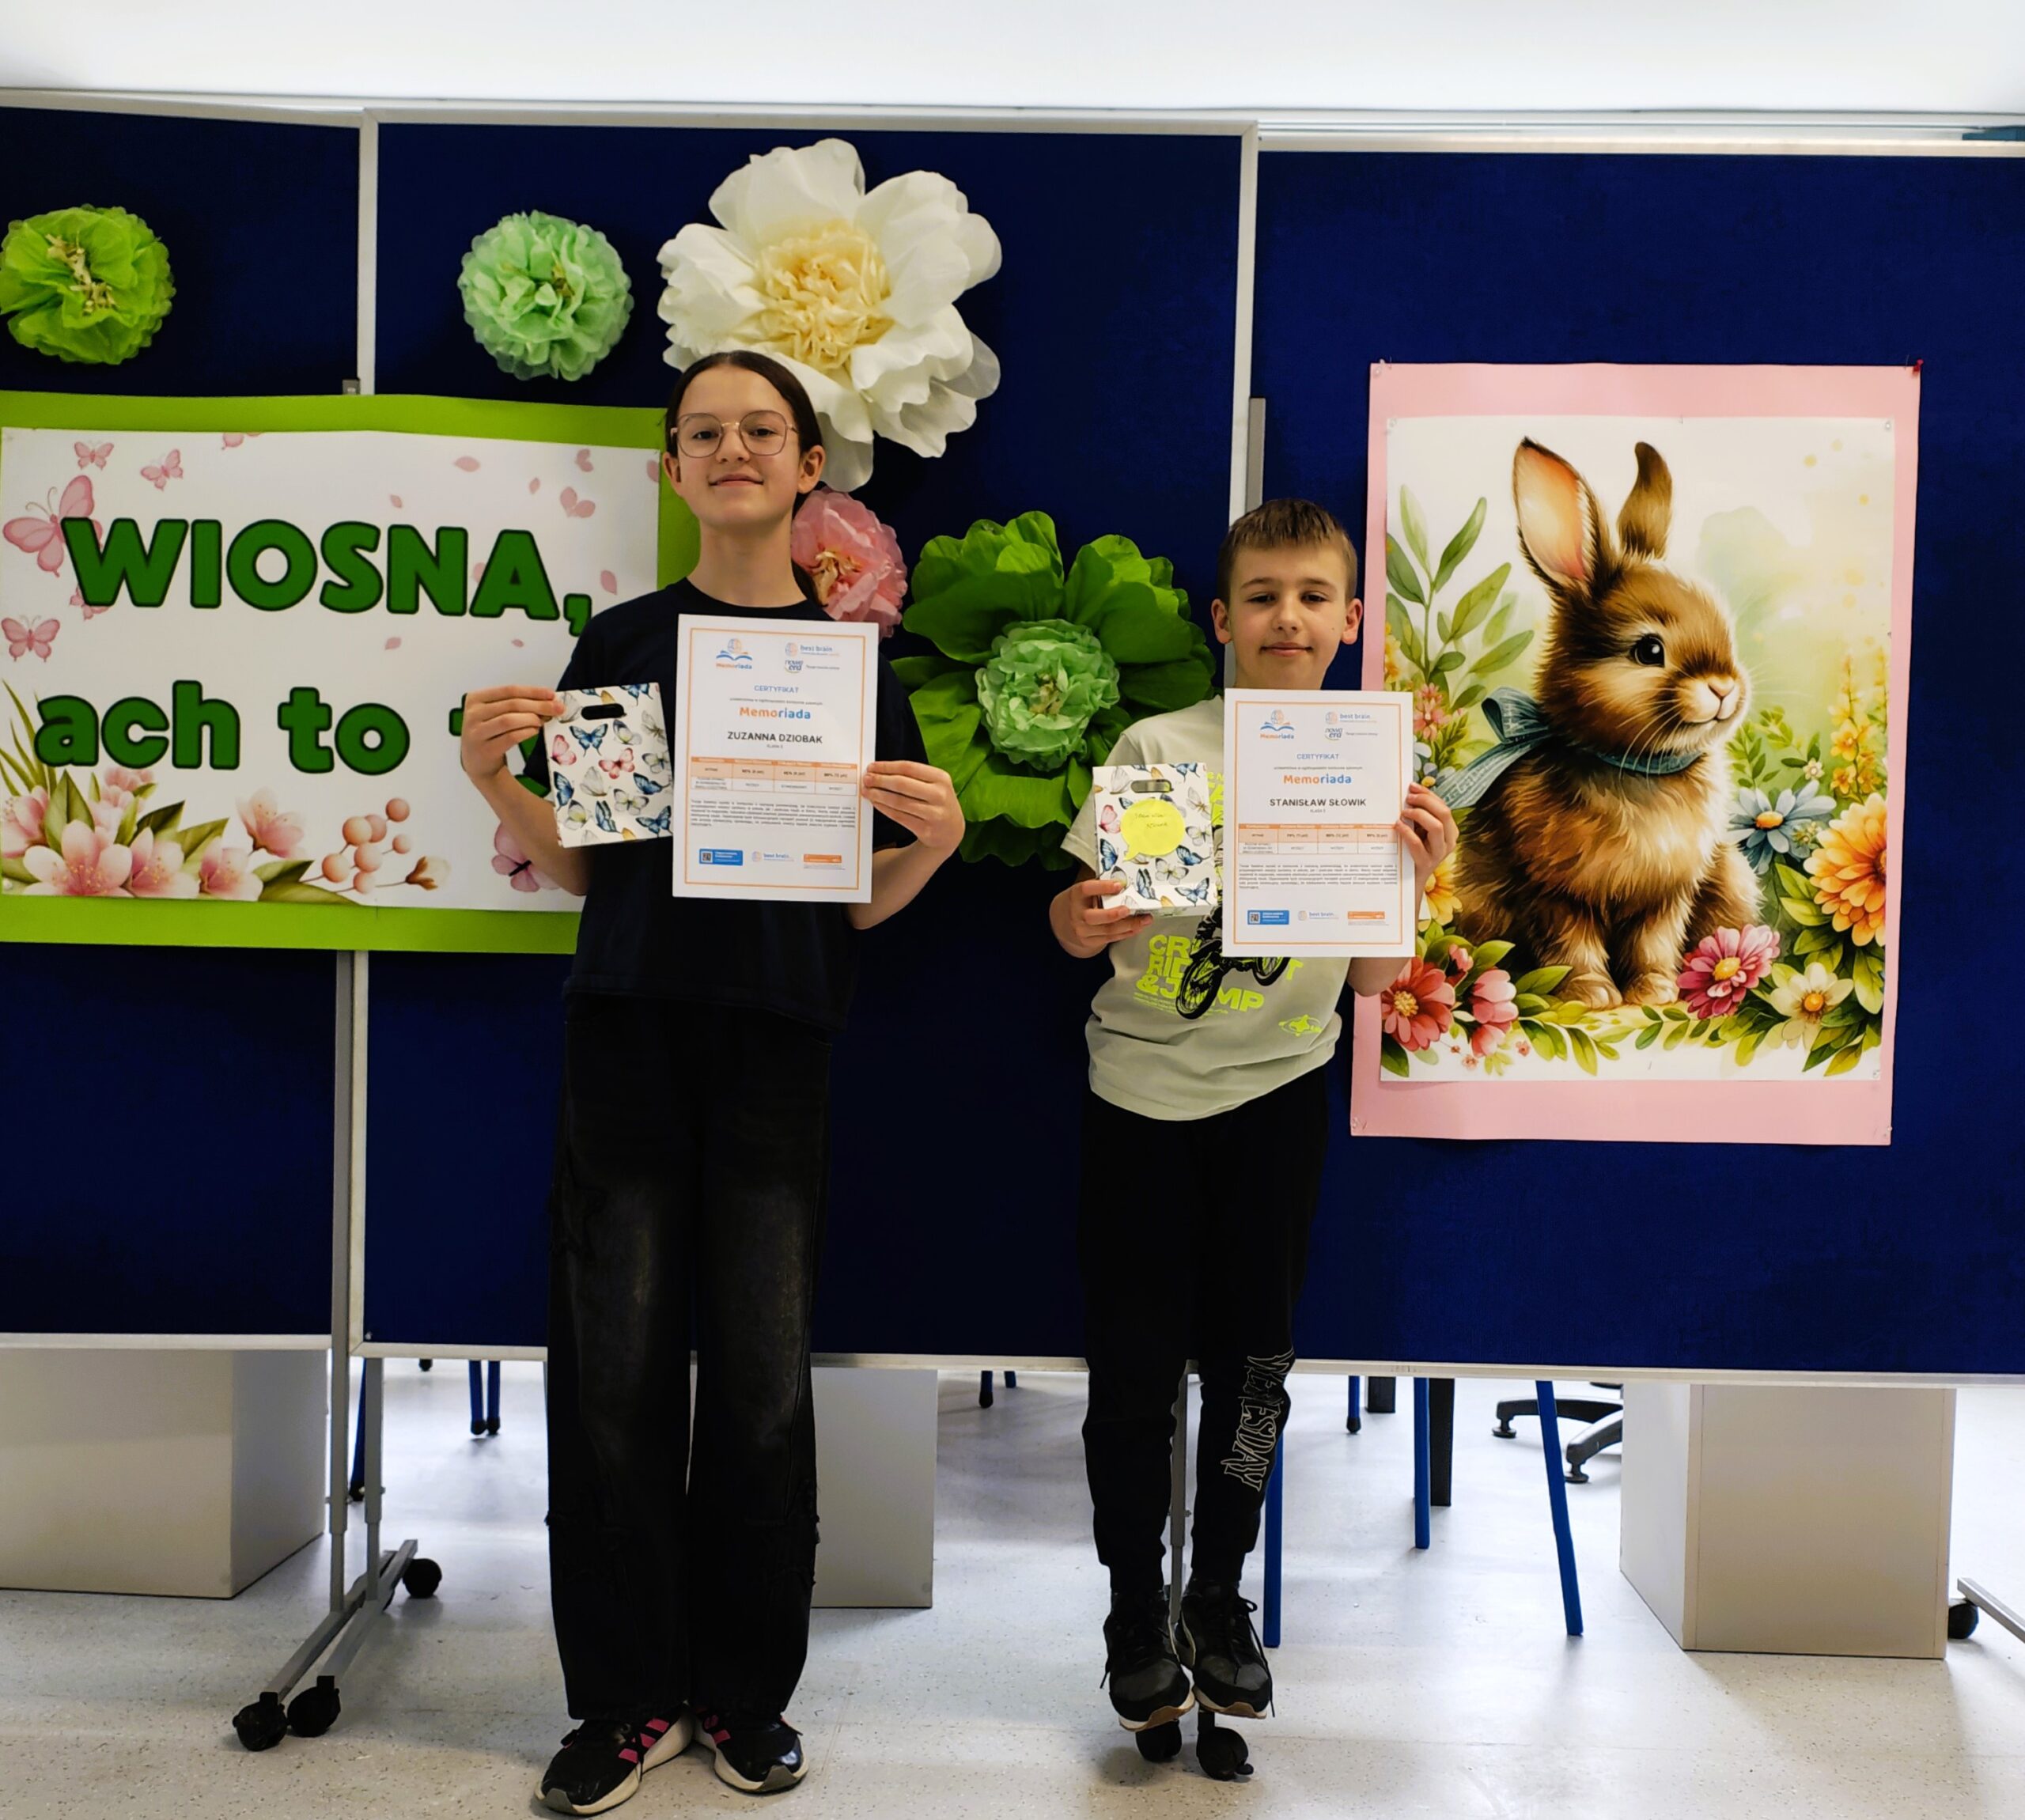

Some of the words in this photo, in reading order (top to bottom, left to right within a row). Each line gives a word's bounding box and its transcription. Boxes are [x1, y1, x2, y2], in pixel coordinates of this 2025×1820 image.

[60, 518, 593, 637] WIOSNA,
[754, 685, 799, 694] CERTYFIKAT
[739, 706, 811, 720] Memoriada
[34, 679, 240, 770] ach
[277, 686, 411, 776] to
[727, 731, 776, 742] ZUZANNA
[778, 734, 823, 744] DZIOBAK
[1283, 774, 1352, 785] Memoriada
[1269, 798, 1327, 807] STANISŁAW
[1329, 798, 1367, 807] SŁOWIK
